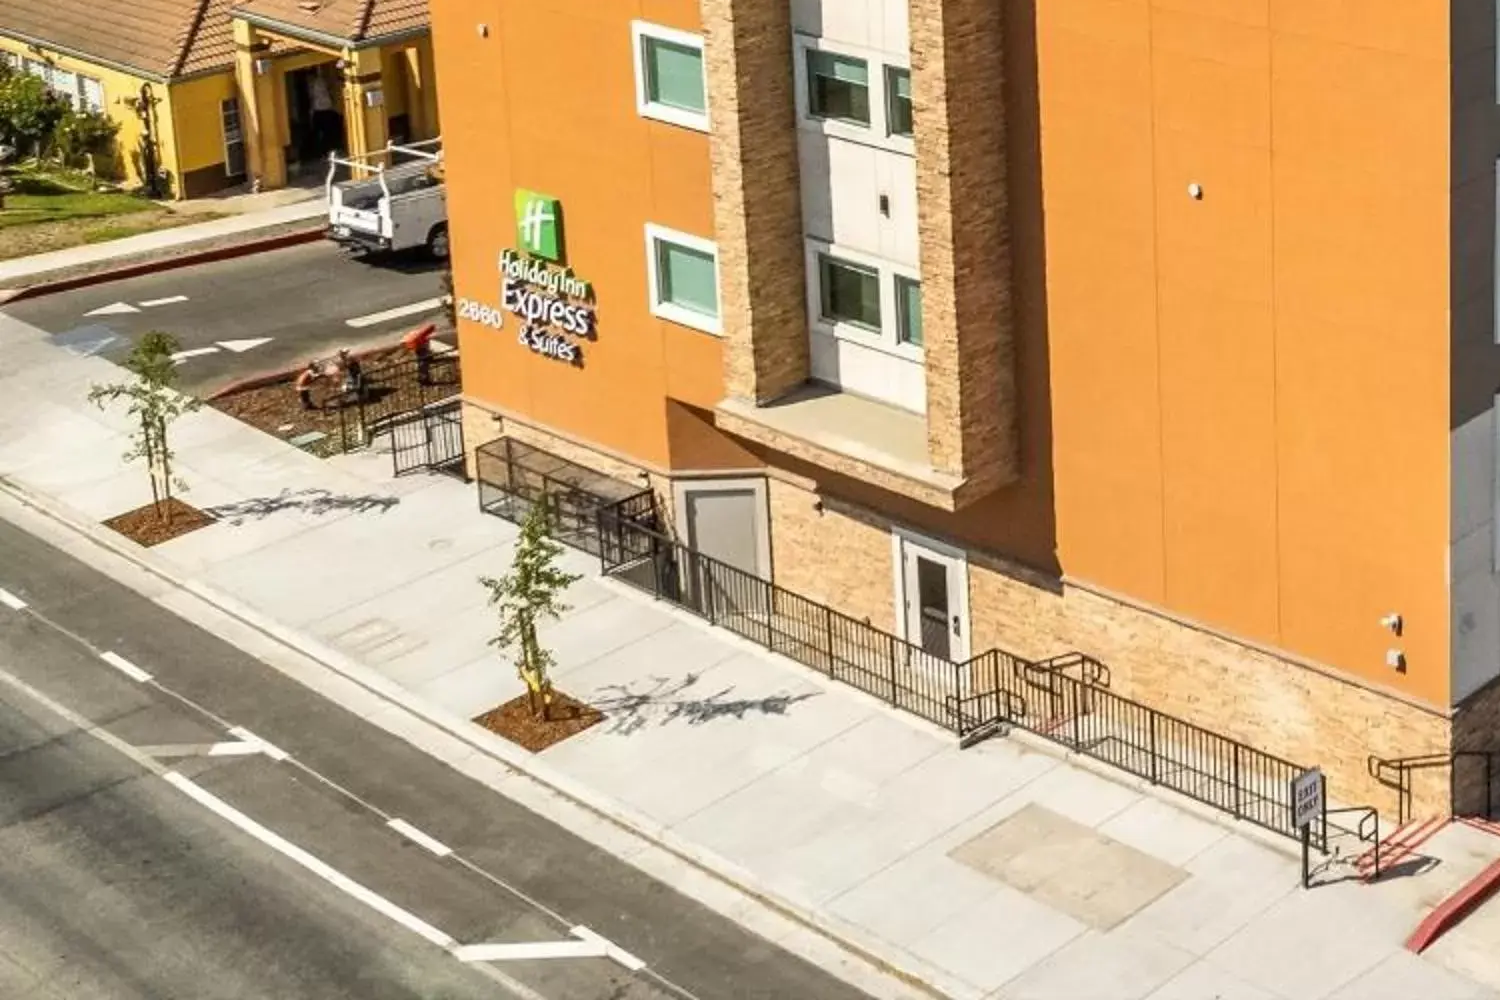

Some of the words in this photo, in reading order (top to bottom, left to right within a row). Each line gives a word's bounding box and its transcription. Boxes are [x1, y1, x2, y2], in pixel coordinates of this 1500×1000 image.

[499, 248, 559, 293] Holiday
[502, 278, 589, 335] Express
[530, 327, 575, 362] Suites
[1298, 780, 1317, 803] EXIT
[1298, 793, 1319, 817] ONLY
